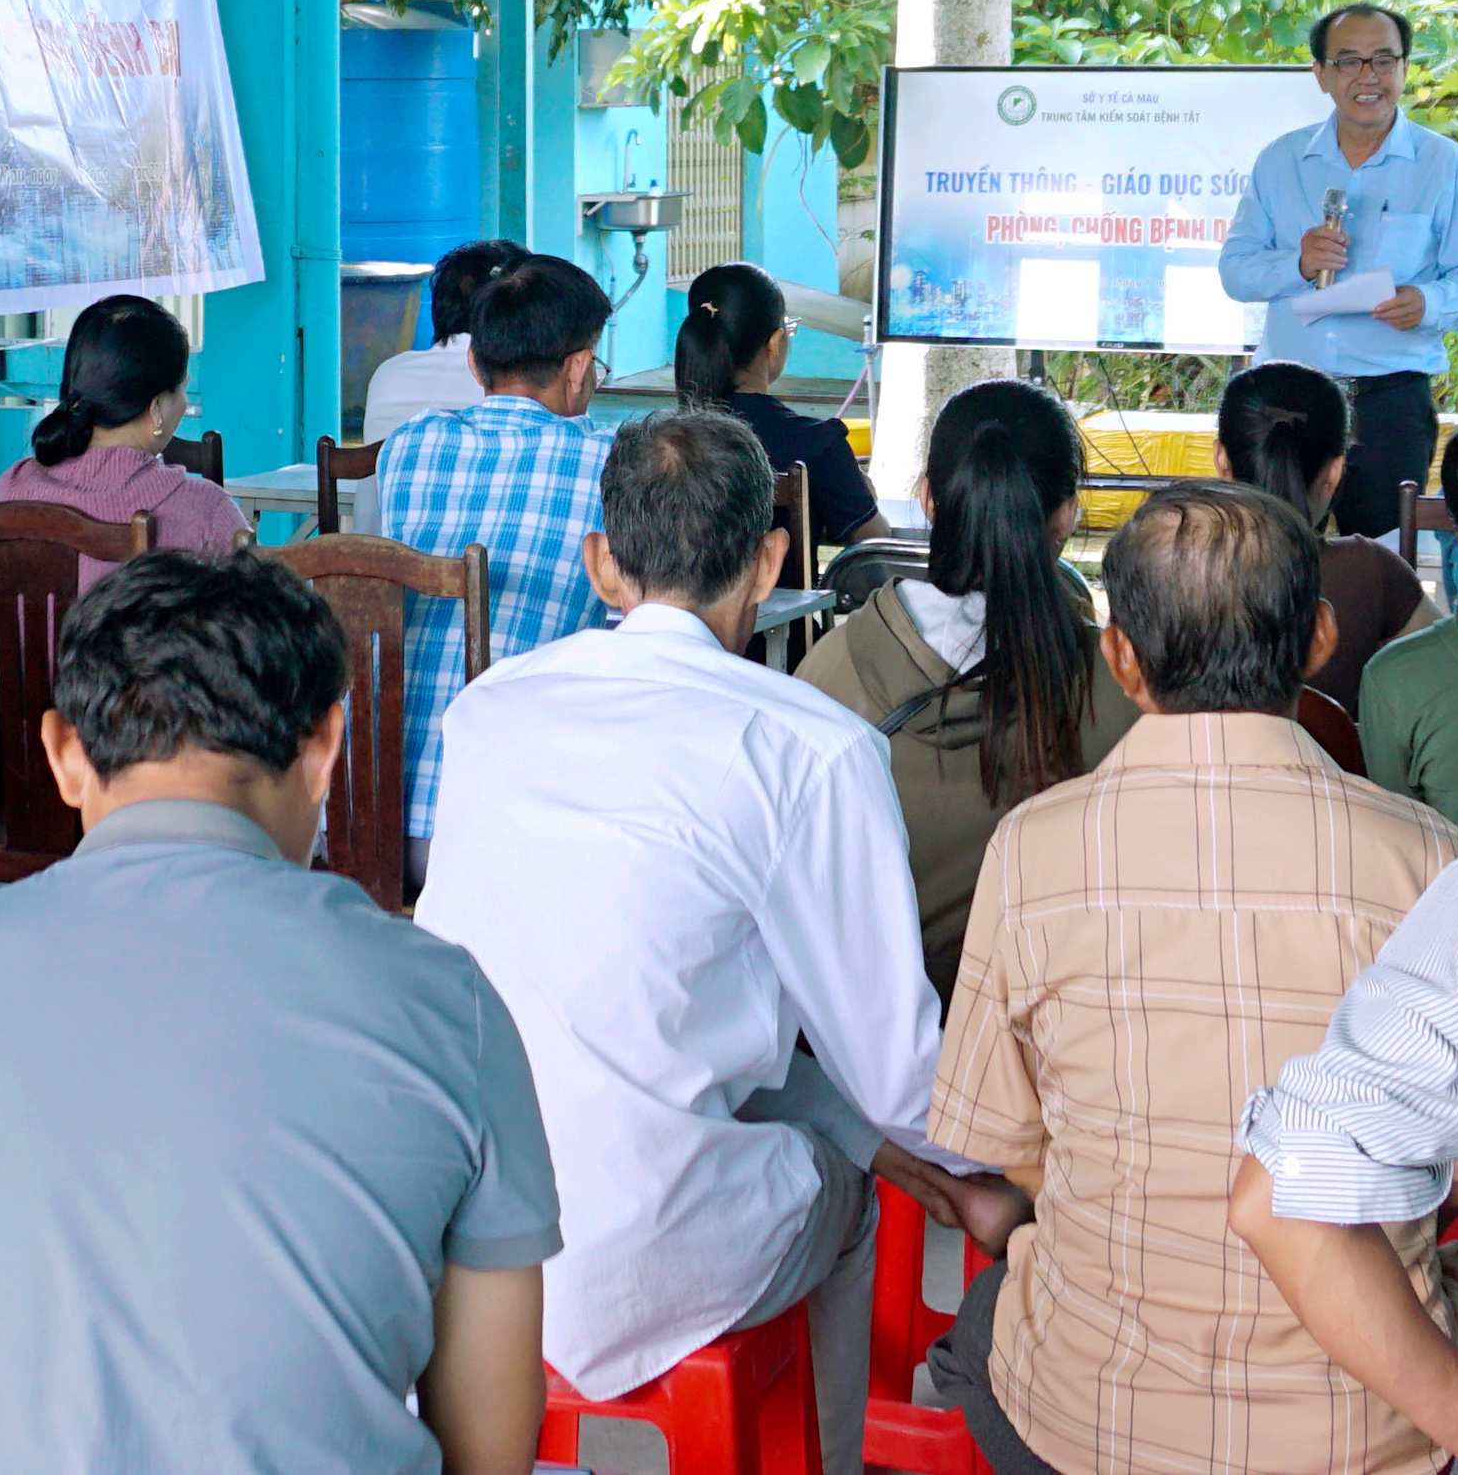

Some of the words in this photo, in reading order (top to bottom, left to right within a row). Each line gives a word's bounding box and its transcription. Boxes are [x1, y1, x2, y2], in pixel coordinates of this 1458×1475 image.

[1082, 92, 1095, 104] SỞ
[1099, 93, 1106, 104] Y
[1137, 93, 1159, 104] MAU
[1041, 111, 1072, 123] TRUNG
[1075, 109, 1096, 123] TÂM
[1154, 109, 1180, 125] BỆNH
[925, 164, 1002, 194] TRUYỀN
[1009, 165, 1078, 194] THÔNG
[1102, 166, 1152, 195] GIÁO
[1159, 173, 1203, 201] DỤC
